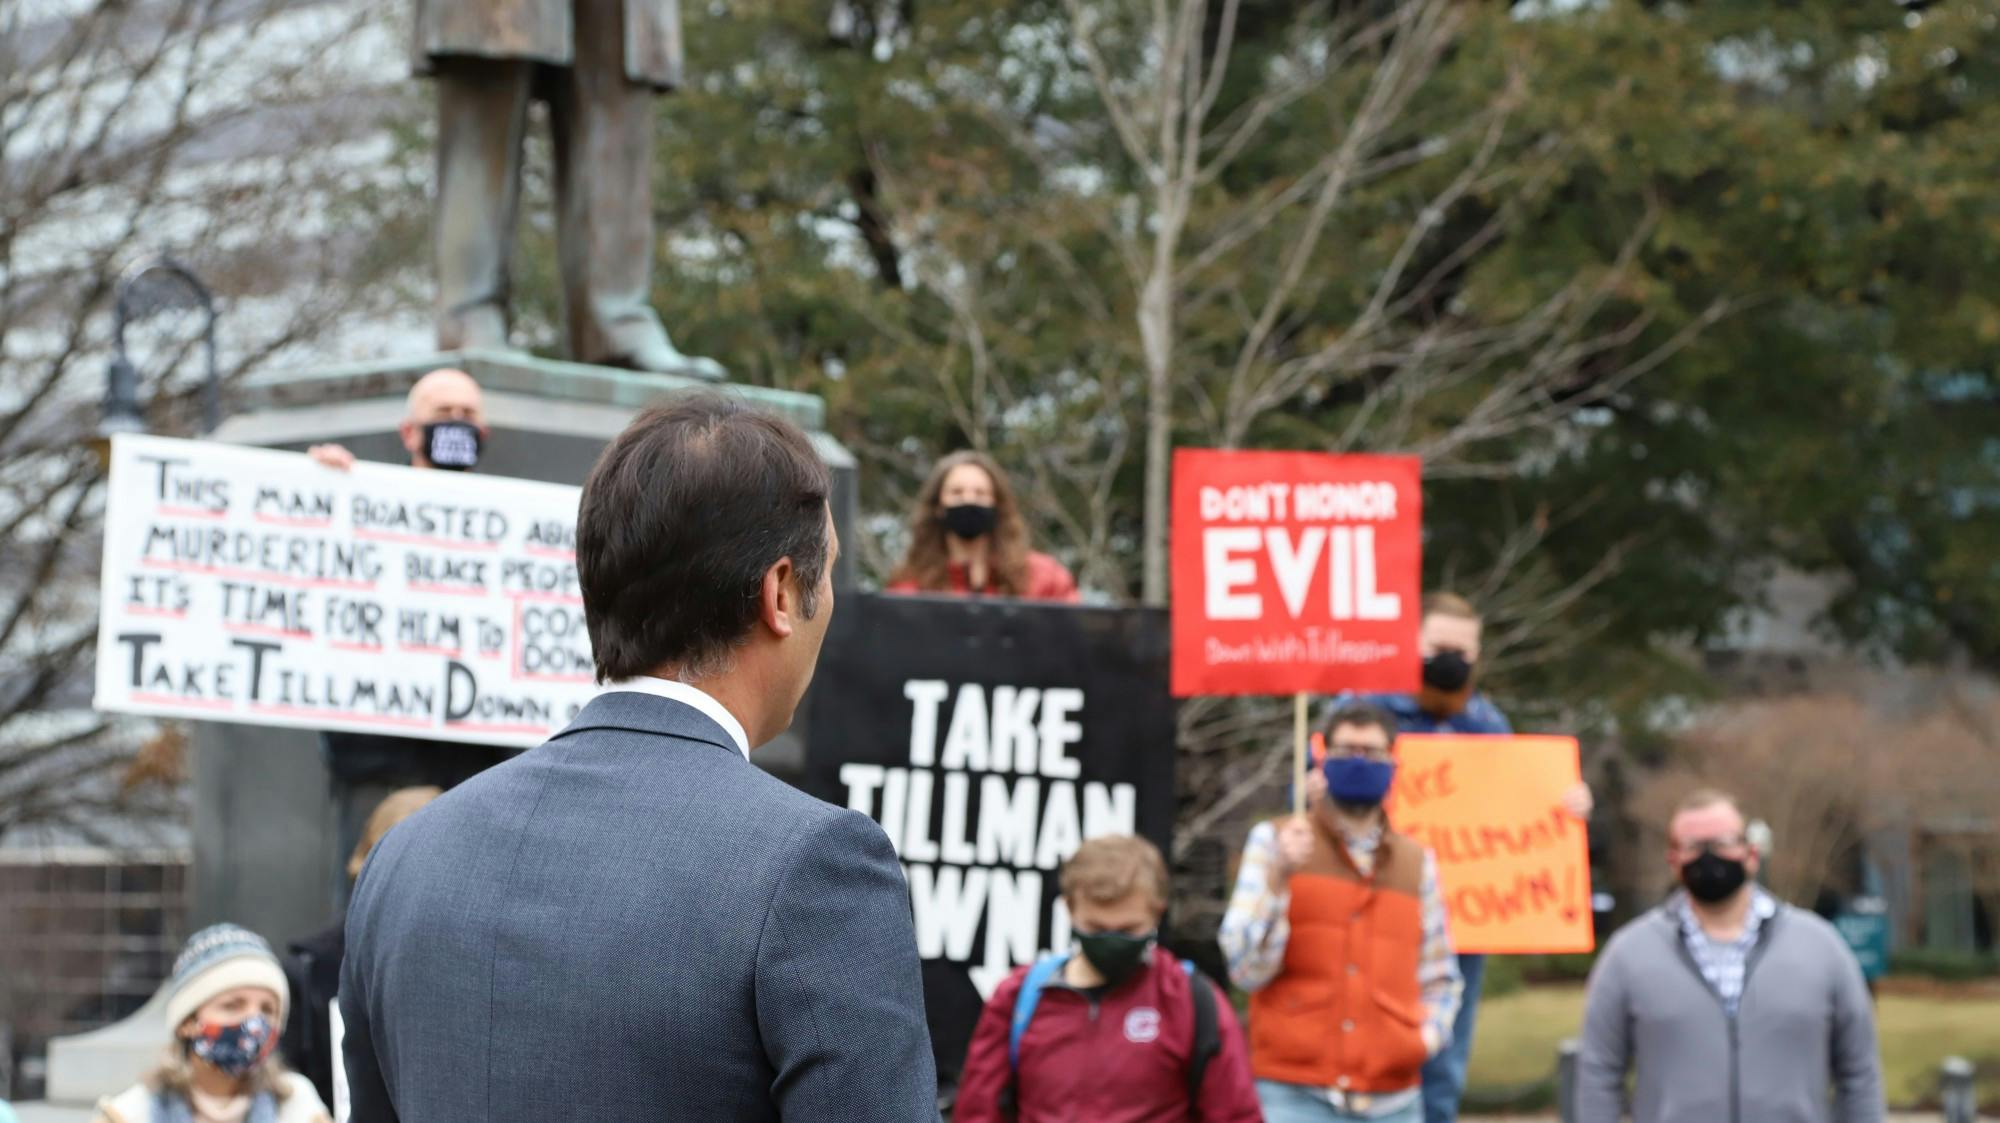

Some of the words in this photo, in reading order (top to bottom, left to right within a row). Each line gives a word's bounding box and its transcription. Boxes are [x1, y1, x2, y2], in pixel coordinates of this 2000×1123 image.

[254, 488, 334, 516] MAN
[351, 494, 508, 542] BOASTED
[1200, 481, 1289, 521] DON'T
[1293, 480, 1397, 521] HONOR
[143, 525, 383, 579] MURDERING
[405, 552, 486, 586] BLACK
[501, 558, 578, 592] PEOP
[1203, 525, 1401, 620] EVIL
[220, 580, 313, 633] TIME
[324, 593, 384, 645] FOR
[398, 608, 461, 649] HIM
[525, 607, 586, 638] CO
[525, 643, 592, 674] DOW
[904, 679, 1084, 779] TAKE
[840, 763, 1136, 870] TILLMAN
[1401, 758, 1458, 808] KE
[908, 862, 1043, 966] WN
[1449, 864, 1579, 929] OWN!
